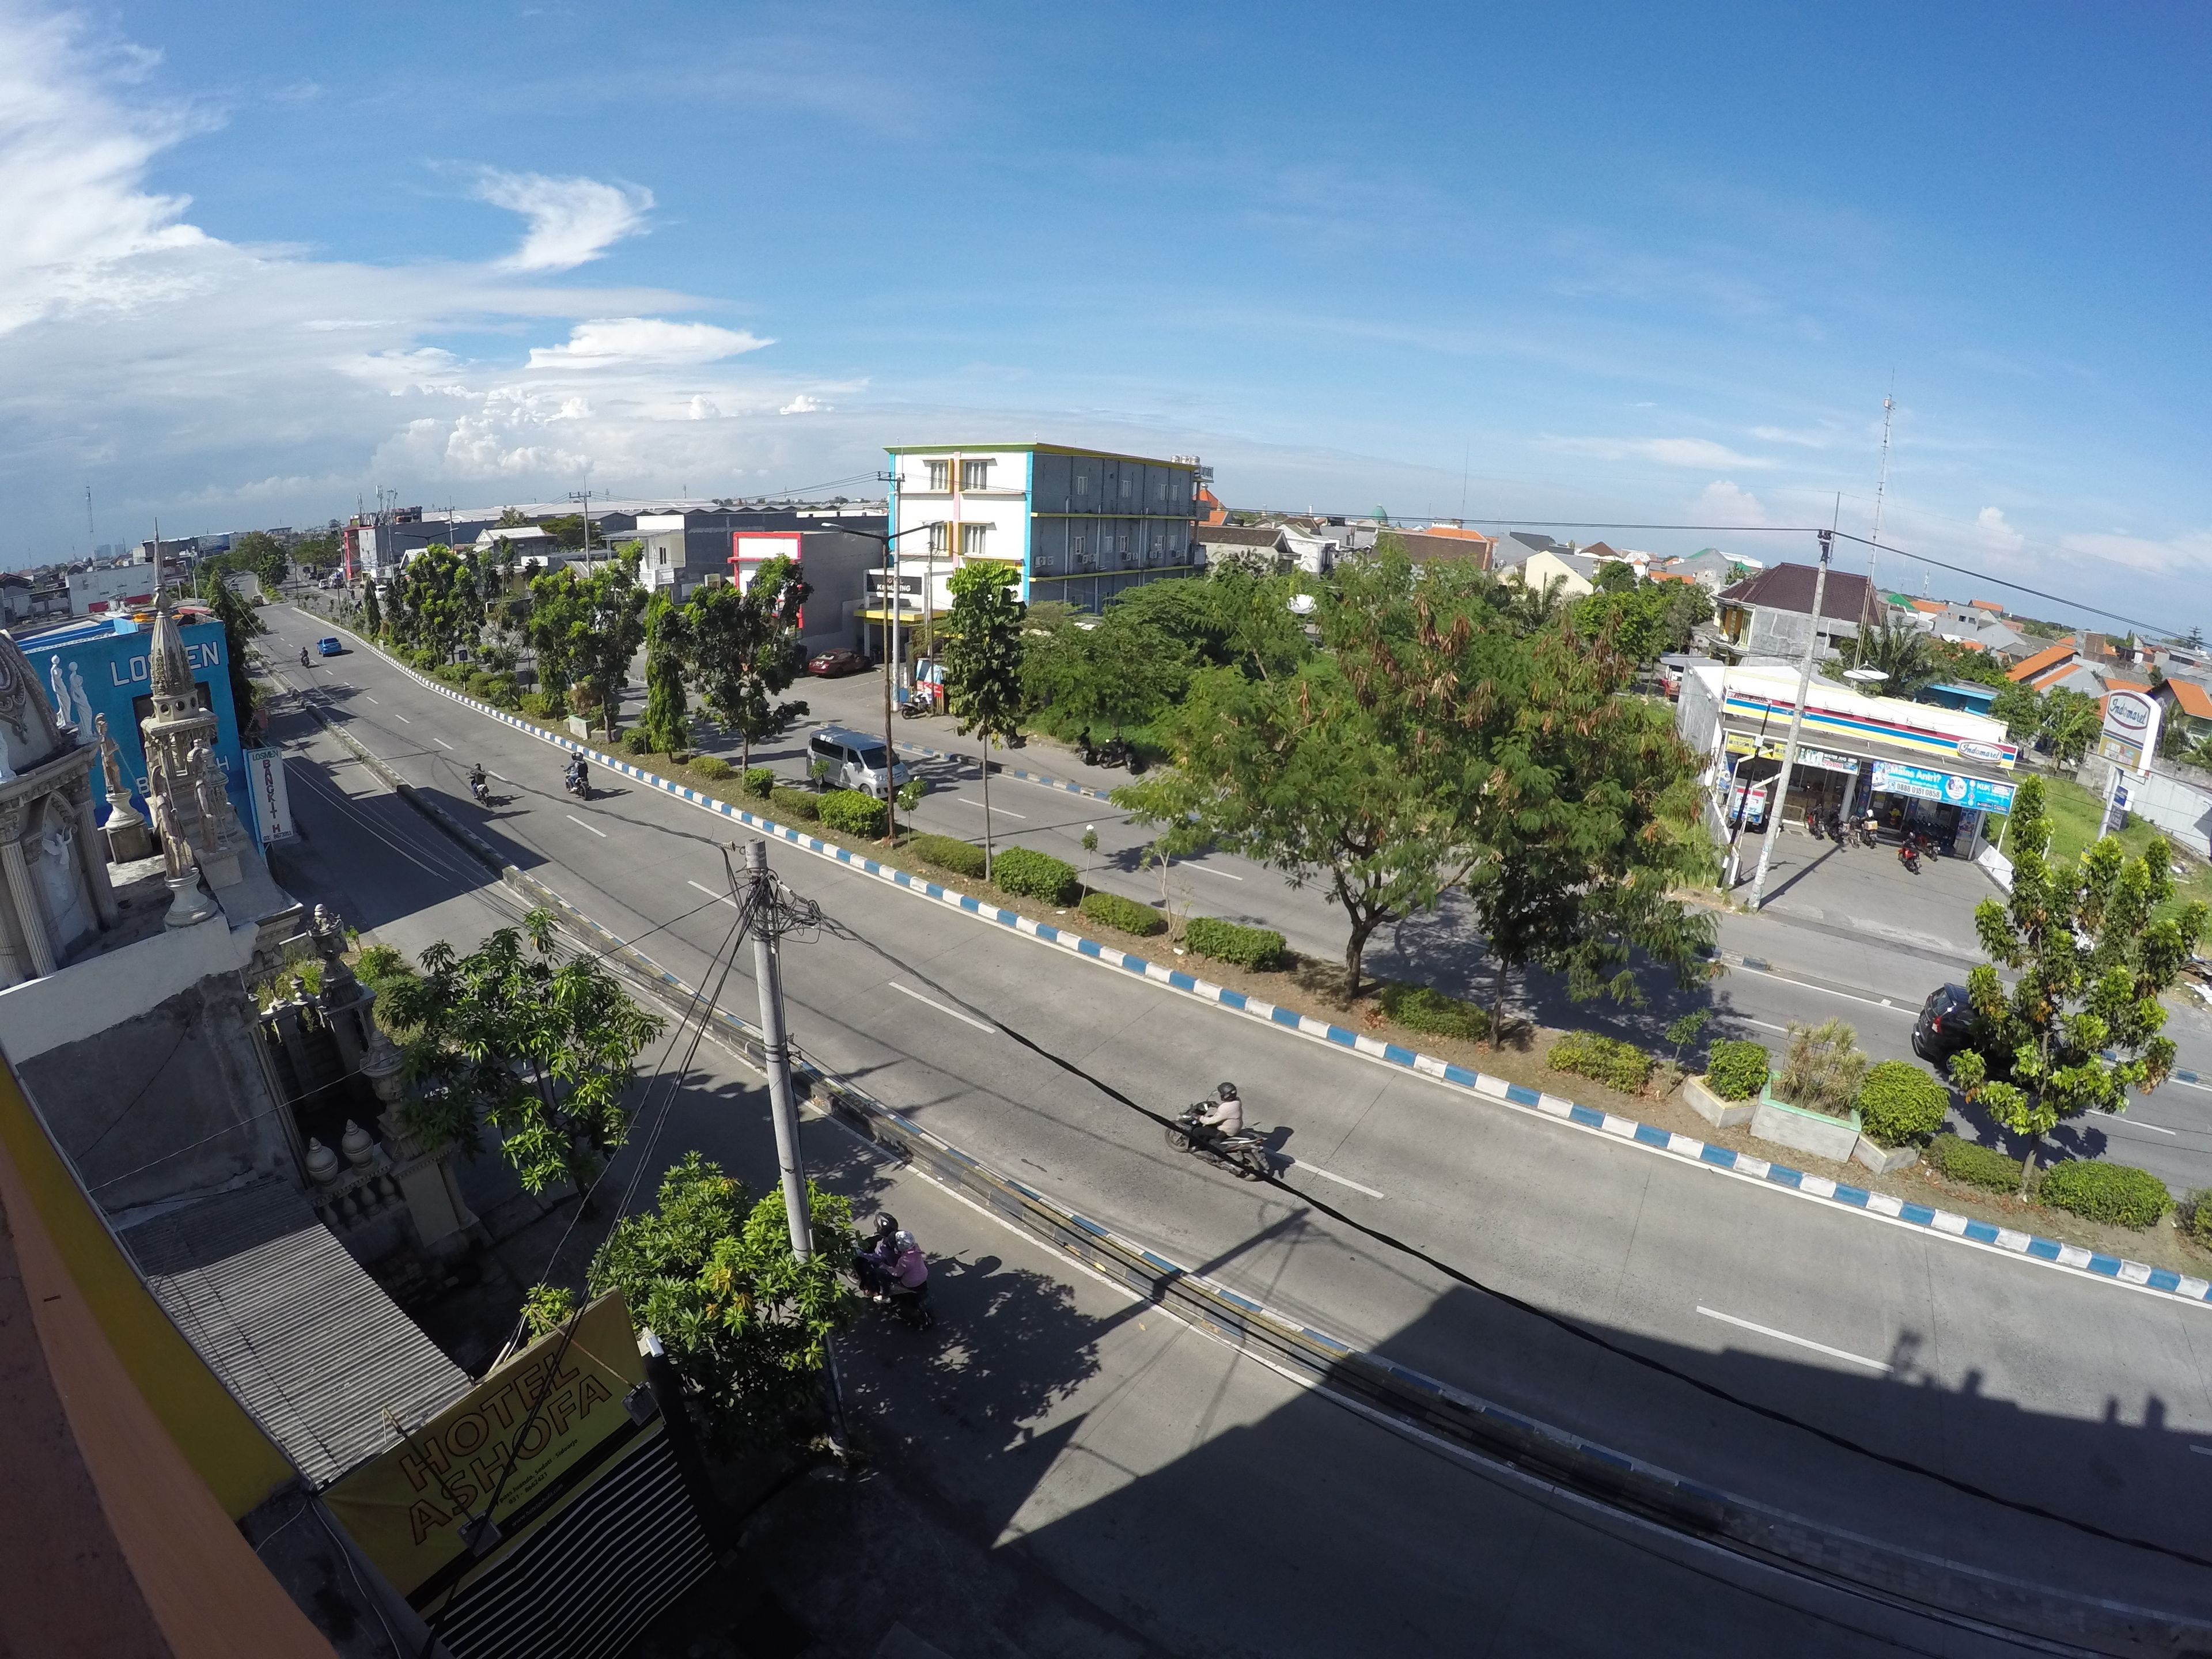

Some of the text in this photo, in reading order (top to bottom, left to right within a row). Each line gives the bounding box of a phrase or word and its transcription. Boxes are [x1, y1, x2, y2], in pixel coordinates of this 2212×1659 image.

[111, 641, 221, 687] LOEN
[2109, 698, 2147, 725] Indomaret
[252, 749, 279, 762] LOSMEN
[1961, 744, 1999, 759] Indomaret
[399, 1353, 580, 1492] HOTEL
[409, 1375, 612, 1546] ASHOFA
[555, 1439, 578, 1459] Sidoarjo
